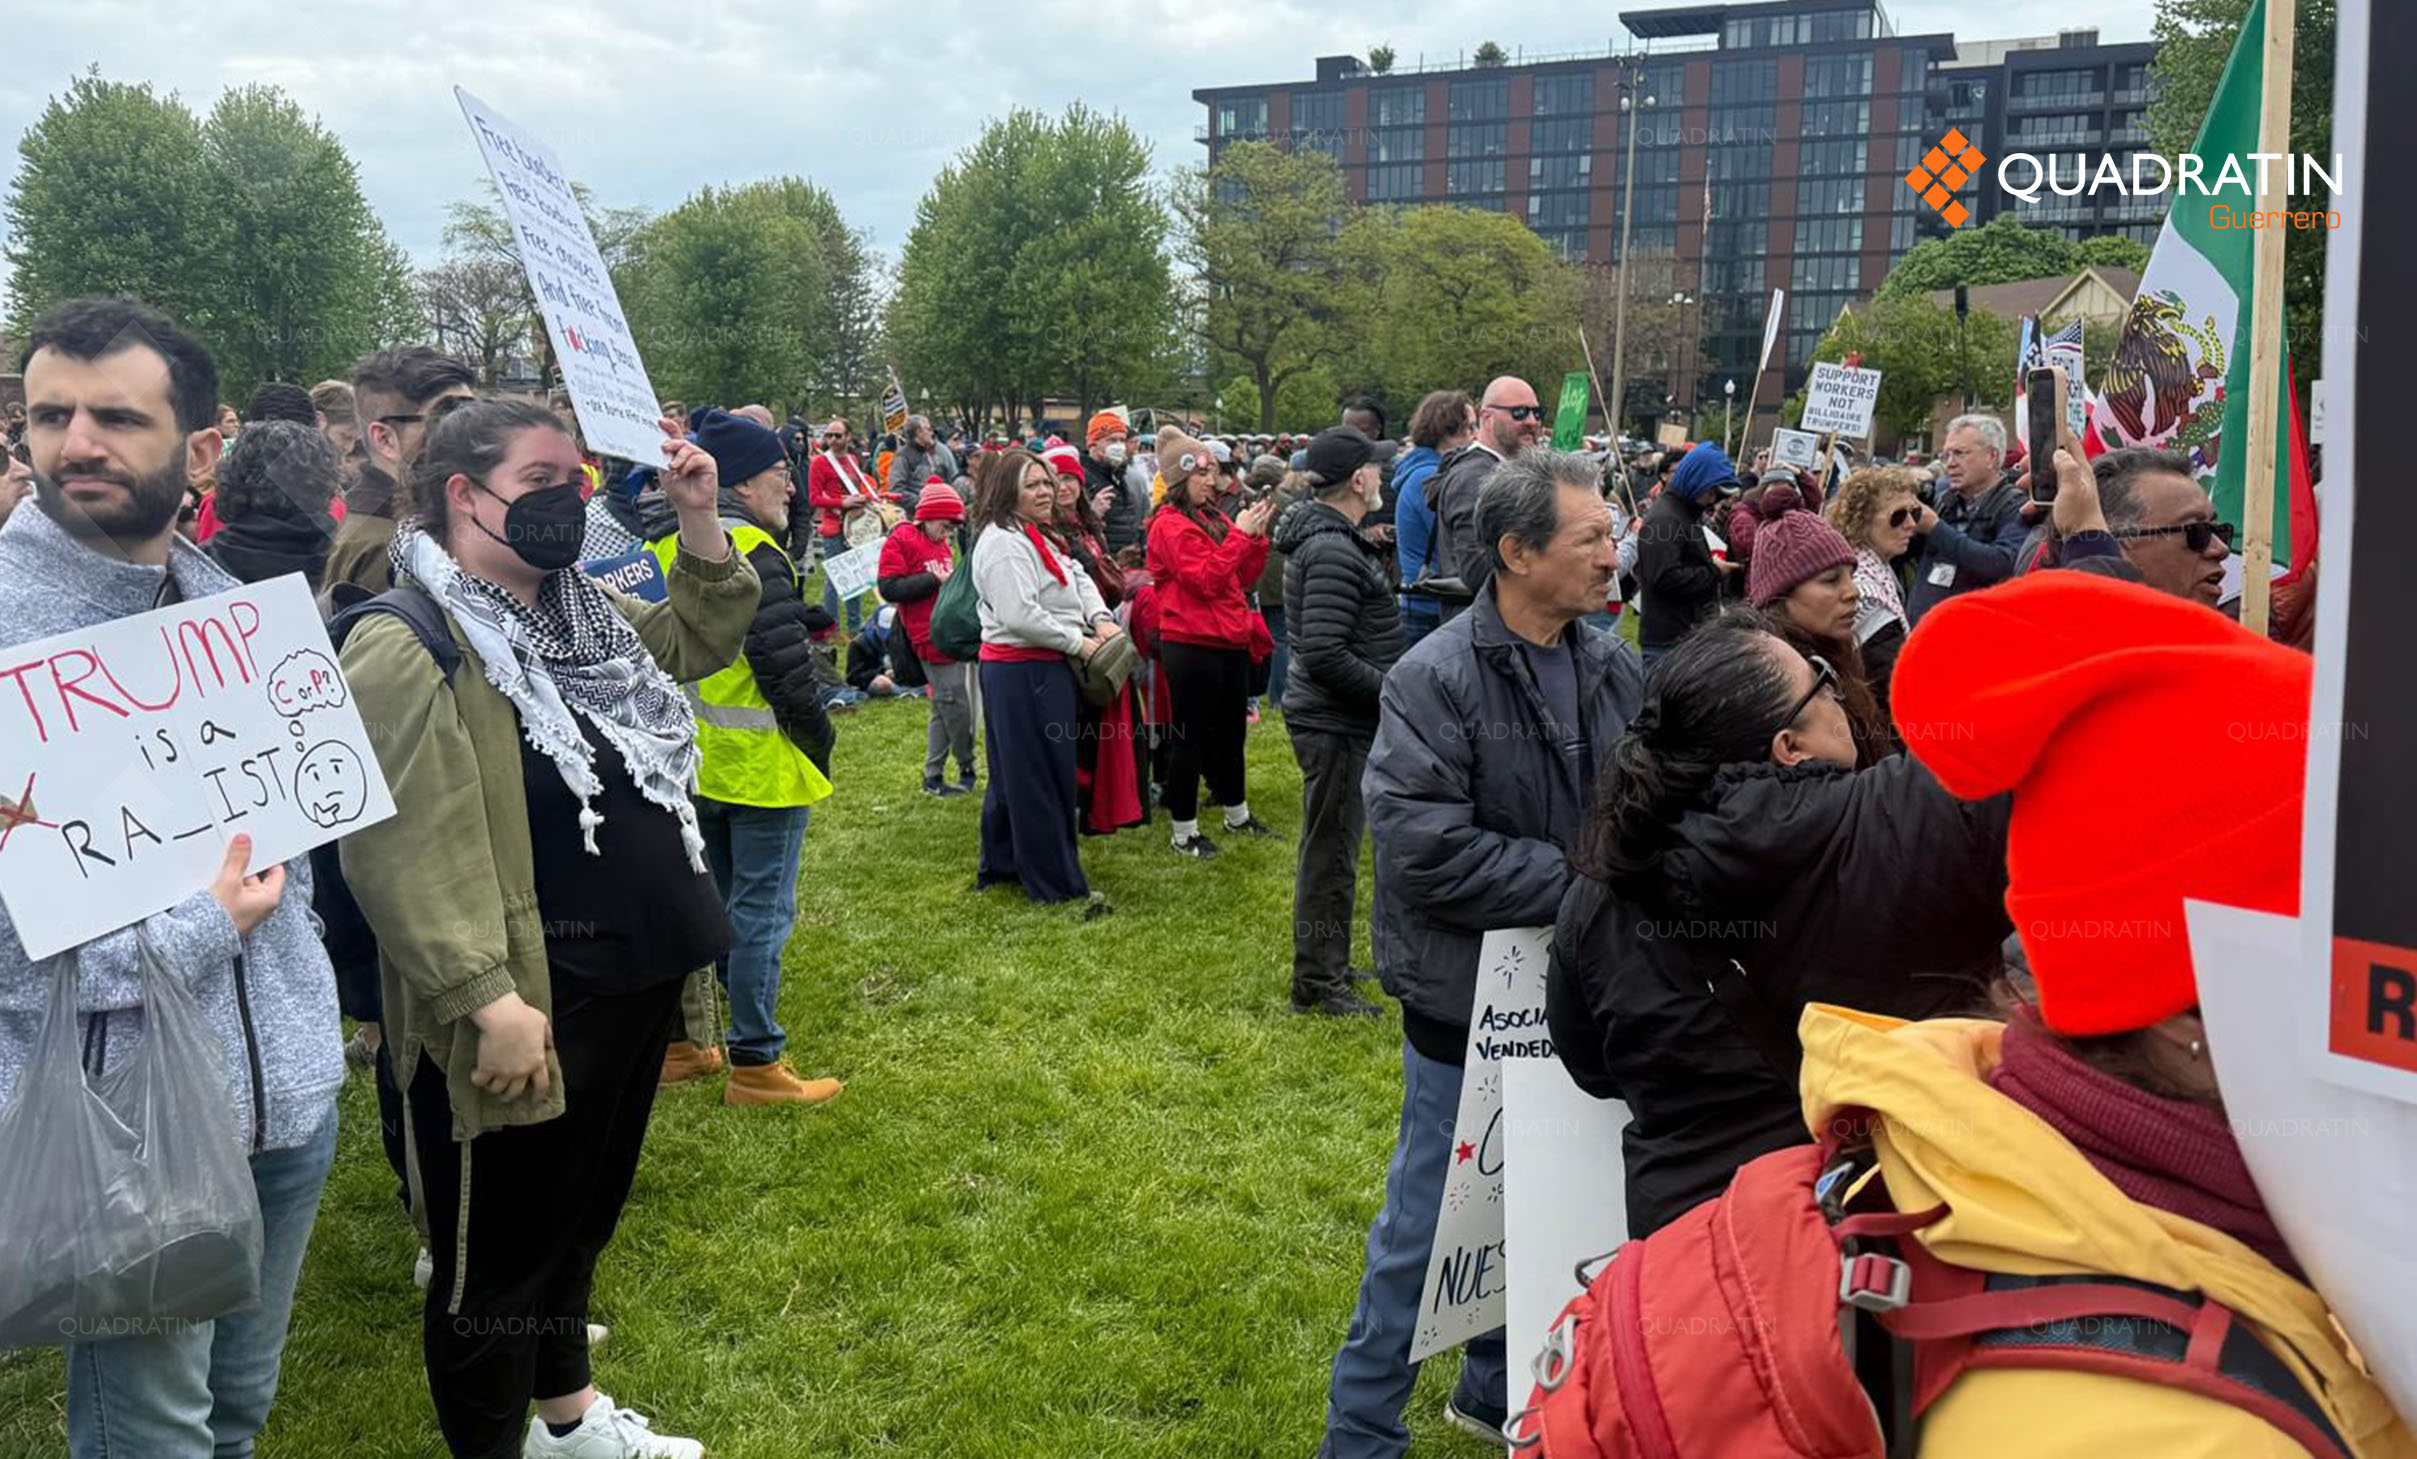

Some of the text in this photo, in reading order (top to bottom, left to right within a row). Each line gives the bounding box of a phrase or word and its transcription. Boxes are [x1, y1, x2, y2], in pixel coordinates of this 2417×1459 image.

[1817, 367, 1877, 386] SUPPORT
[1815, 381, 1875, 400] WORKERS
[1828, 396, 1855, 410] NOT
[0, 602, 260, 743] TRUMP
[135, 720, 237, 771] is a
